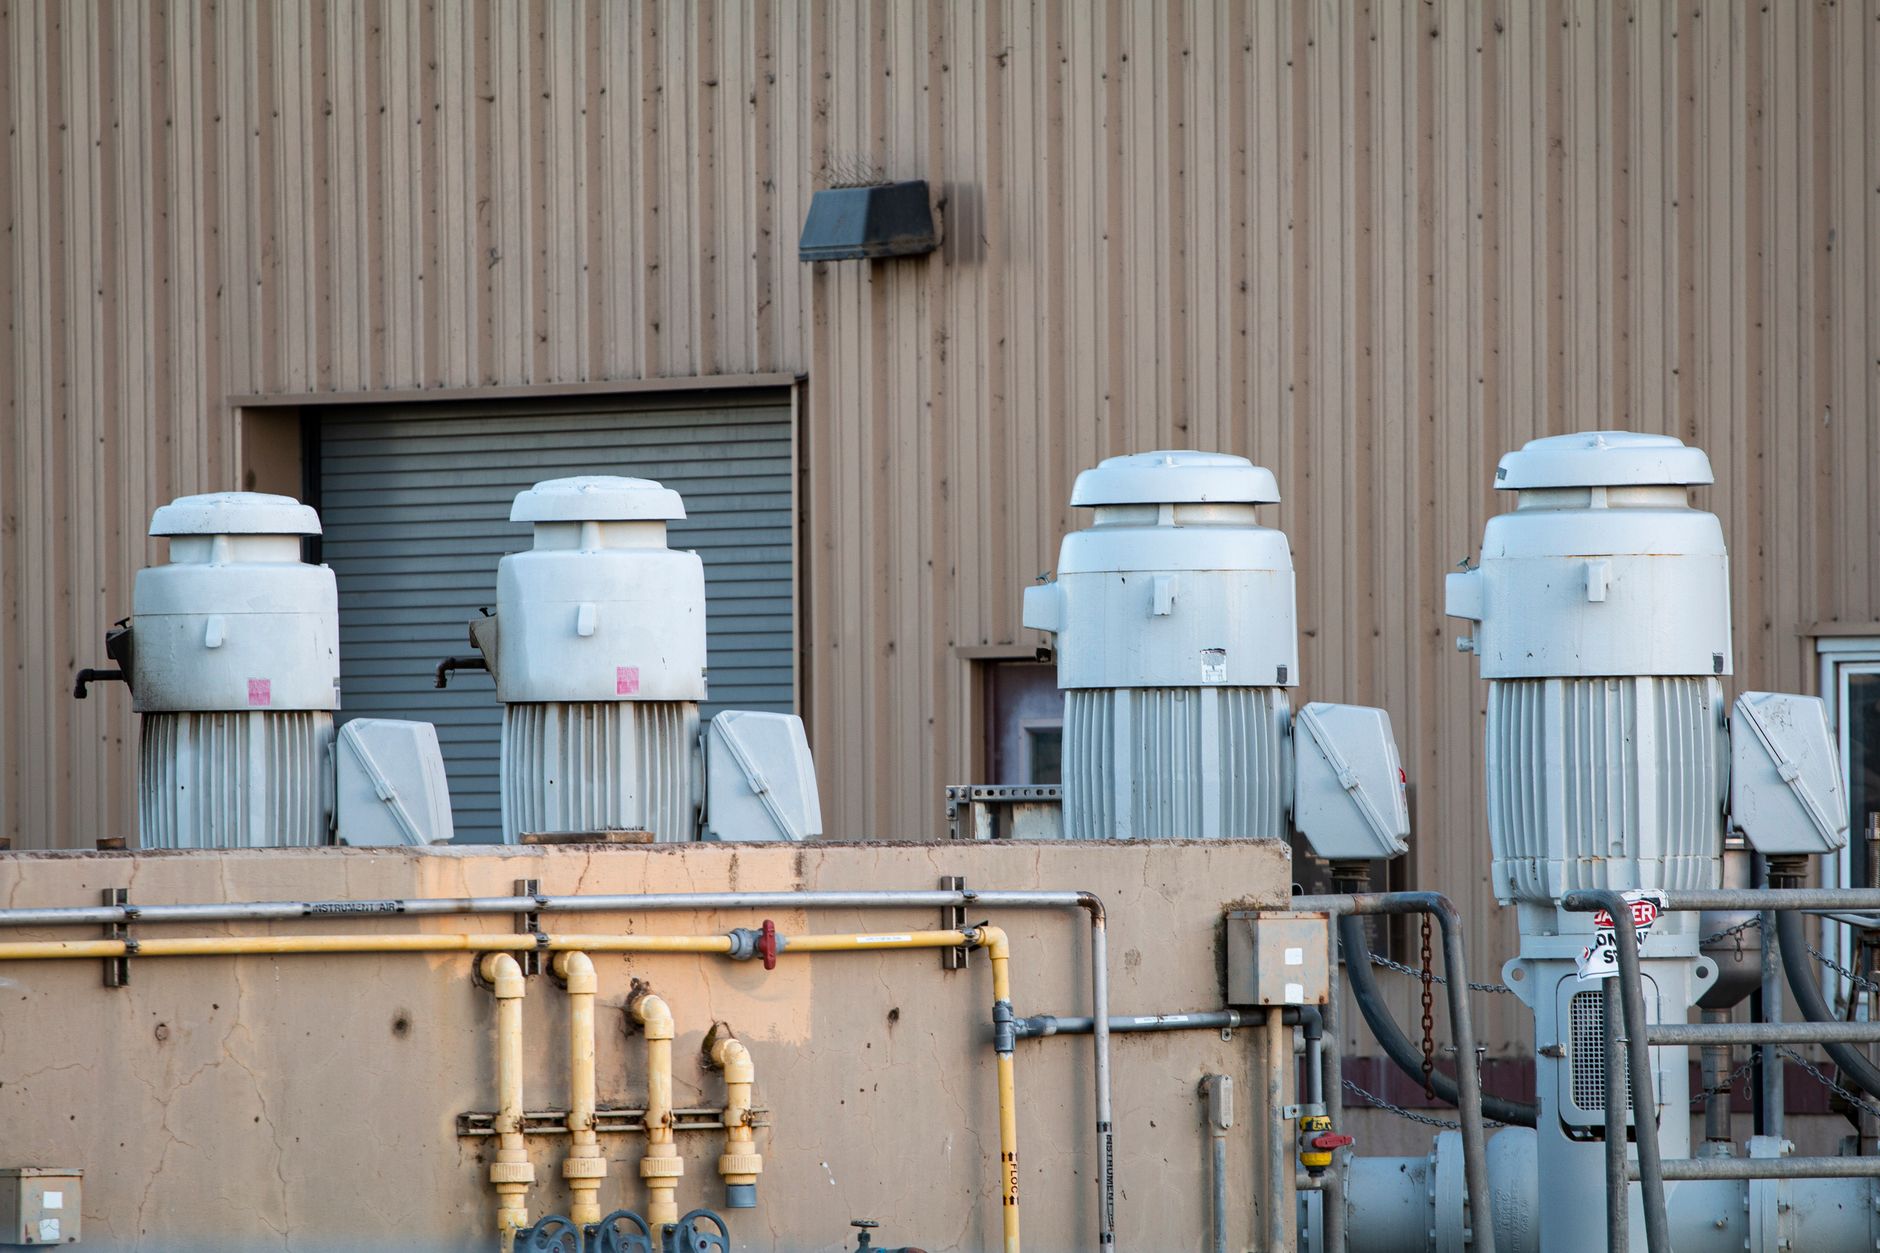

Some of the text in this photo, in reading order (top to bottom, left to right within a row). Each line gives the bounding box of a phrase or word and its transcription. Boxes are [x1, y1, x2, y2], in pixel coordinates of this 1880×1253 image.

[312, 902, 395, 913] INSTRUMENT AIR
[1594, 904, 1653, 922] AER
[1010, 1163, 1018, 1193] FLOC
